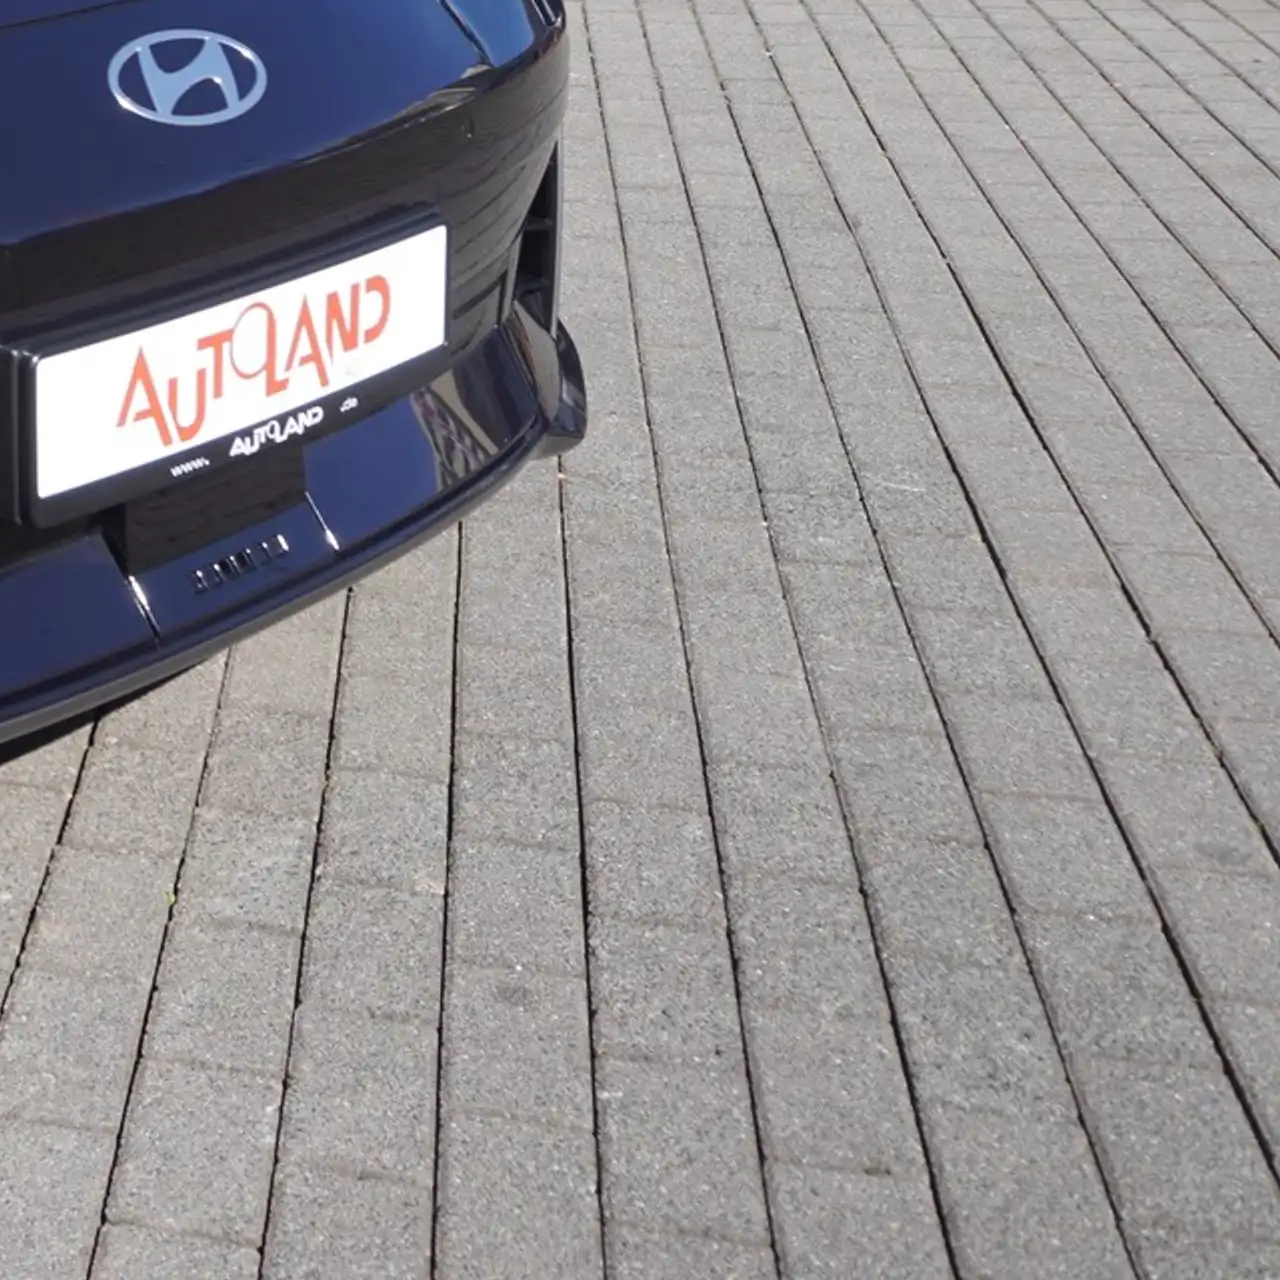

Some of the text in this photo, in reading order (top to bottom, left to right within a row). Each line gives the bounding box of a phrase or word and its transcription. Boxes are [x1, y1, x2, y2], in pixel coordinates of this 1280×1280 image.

[116, 274, 392, 448] AUTOLAND
[229, 406, 324, 458] AUTOLAND
[339, 396, 358, 413] .de
